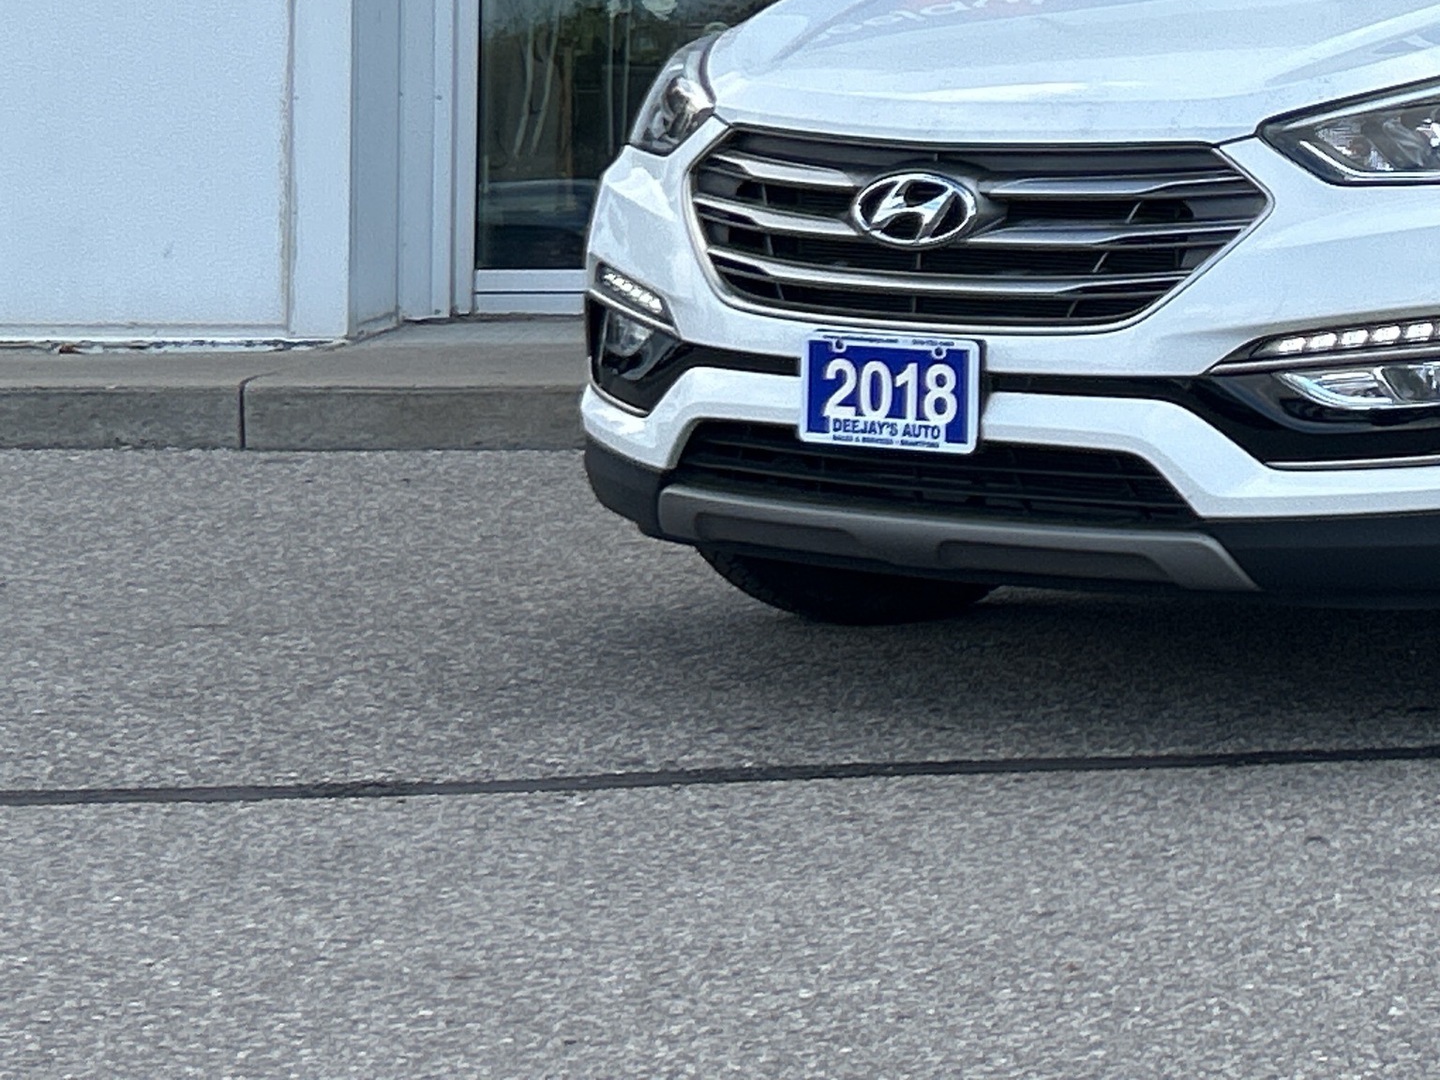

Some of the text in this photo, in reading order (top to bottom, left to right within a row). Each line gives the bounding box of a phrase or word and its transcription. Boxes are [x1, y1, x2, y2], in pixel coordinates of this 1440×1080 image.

[823, 358, 958, 425] 2018
[832, 418, 941, 439] DEEJAY'S AUTO
